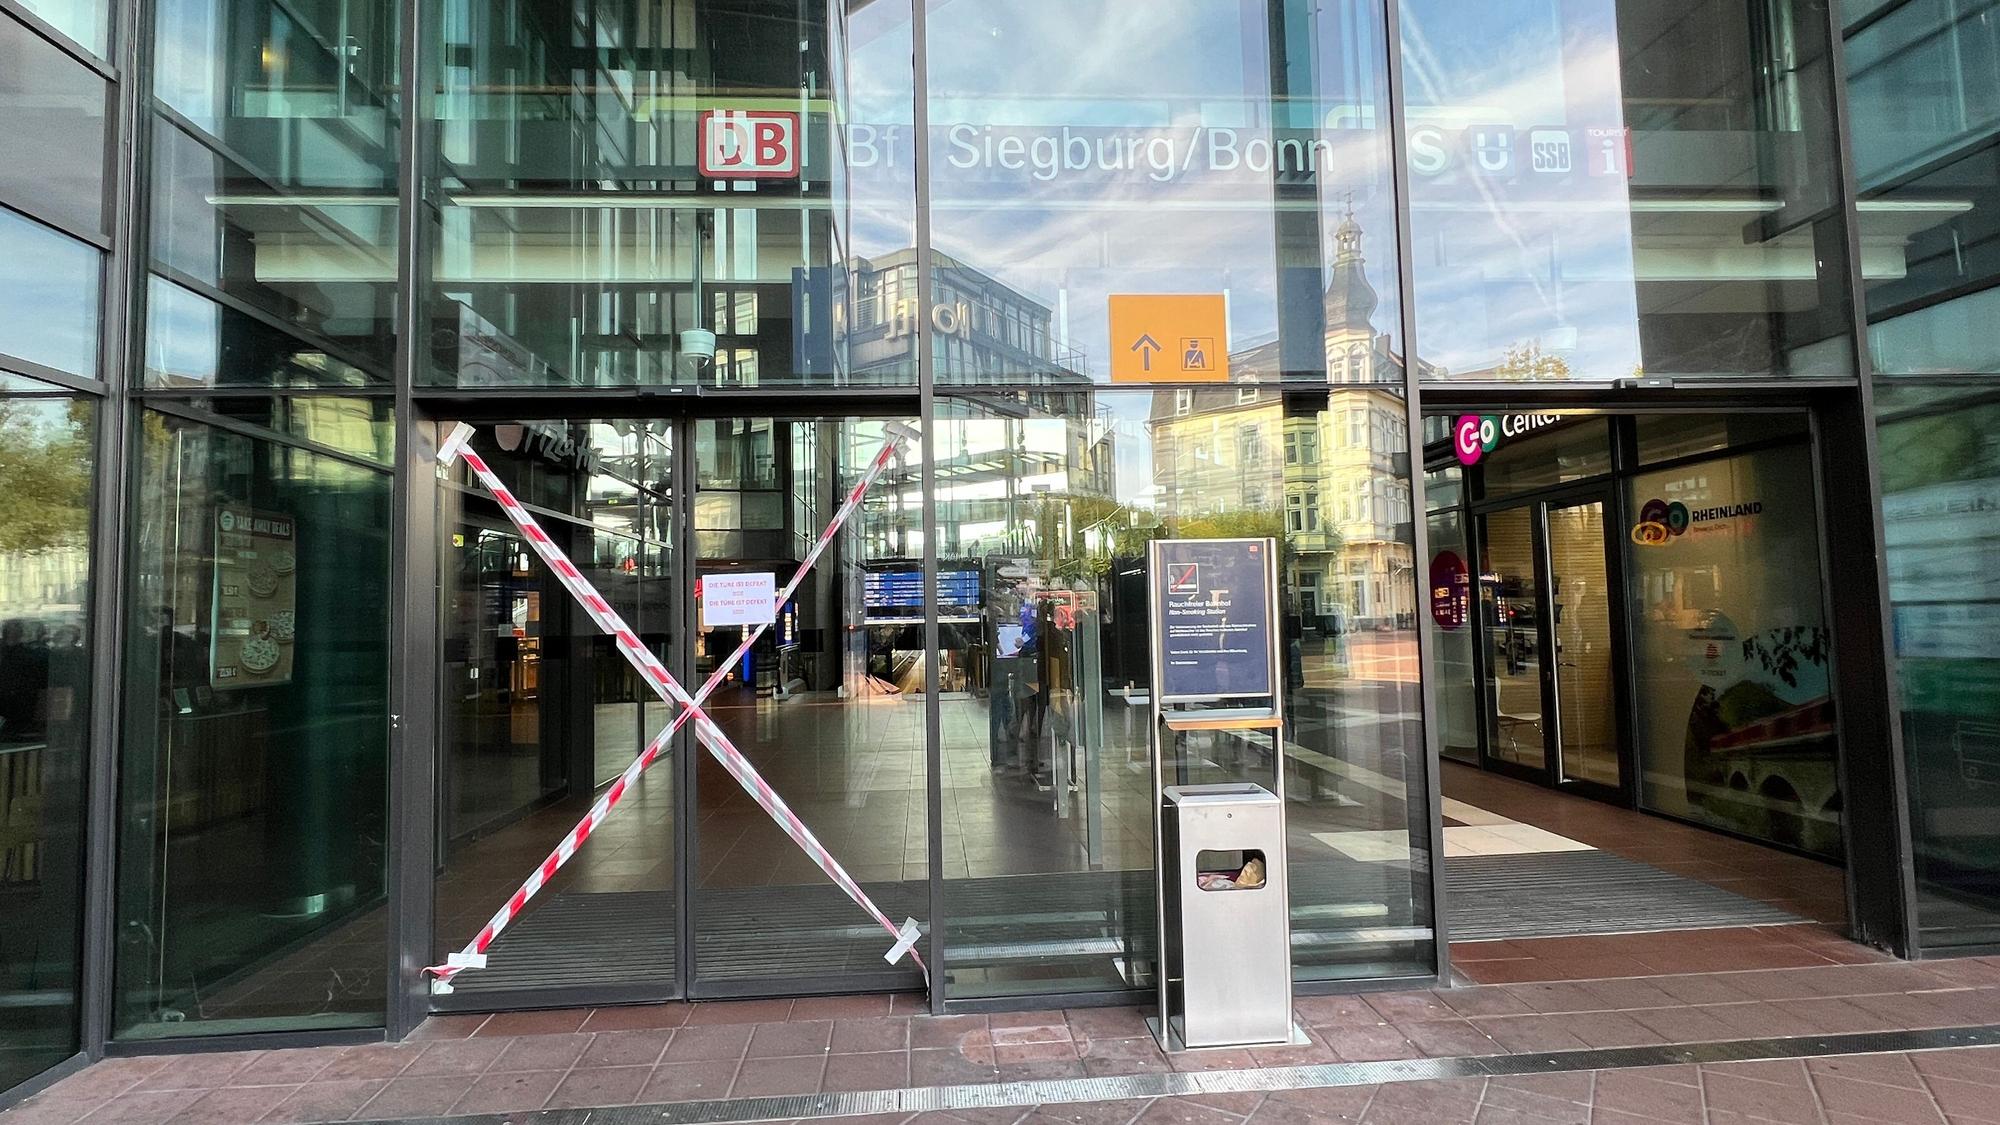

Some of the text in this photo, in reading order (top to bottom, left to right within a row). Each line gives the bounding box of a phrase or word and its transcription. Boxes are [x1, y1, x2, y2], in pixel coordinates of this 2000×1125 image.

[718, 122, 788, 166] DB
[1587, 127, 1629, 137] TOURIST
[848, 123, 1334, 182] Bf Siegburg/Bonn
[1410, 129, 1447, 171] S
[1476, 132, 1509, 171] U
[1533, 142, 1569, 169] SSB
[1692, 501, 1763, 523] RHEINLAND
[271, 521, 291, 537] DEALS
[1168, 599, 1231, 608] Rauchfreier Bahnhof
[1168, 607, 1226, 616] Non-Smoking Station
